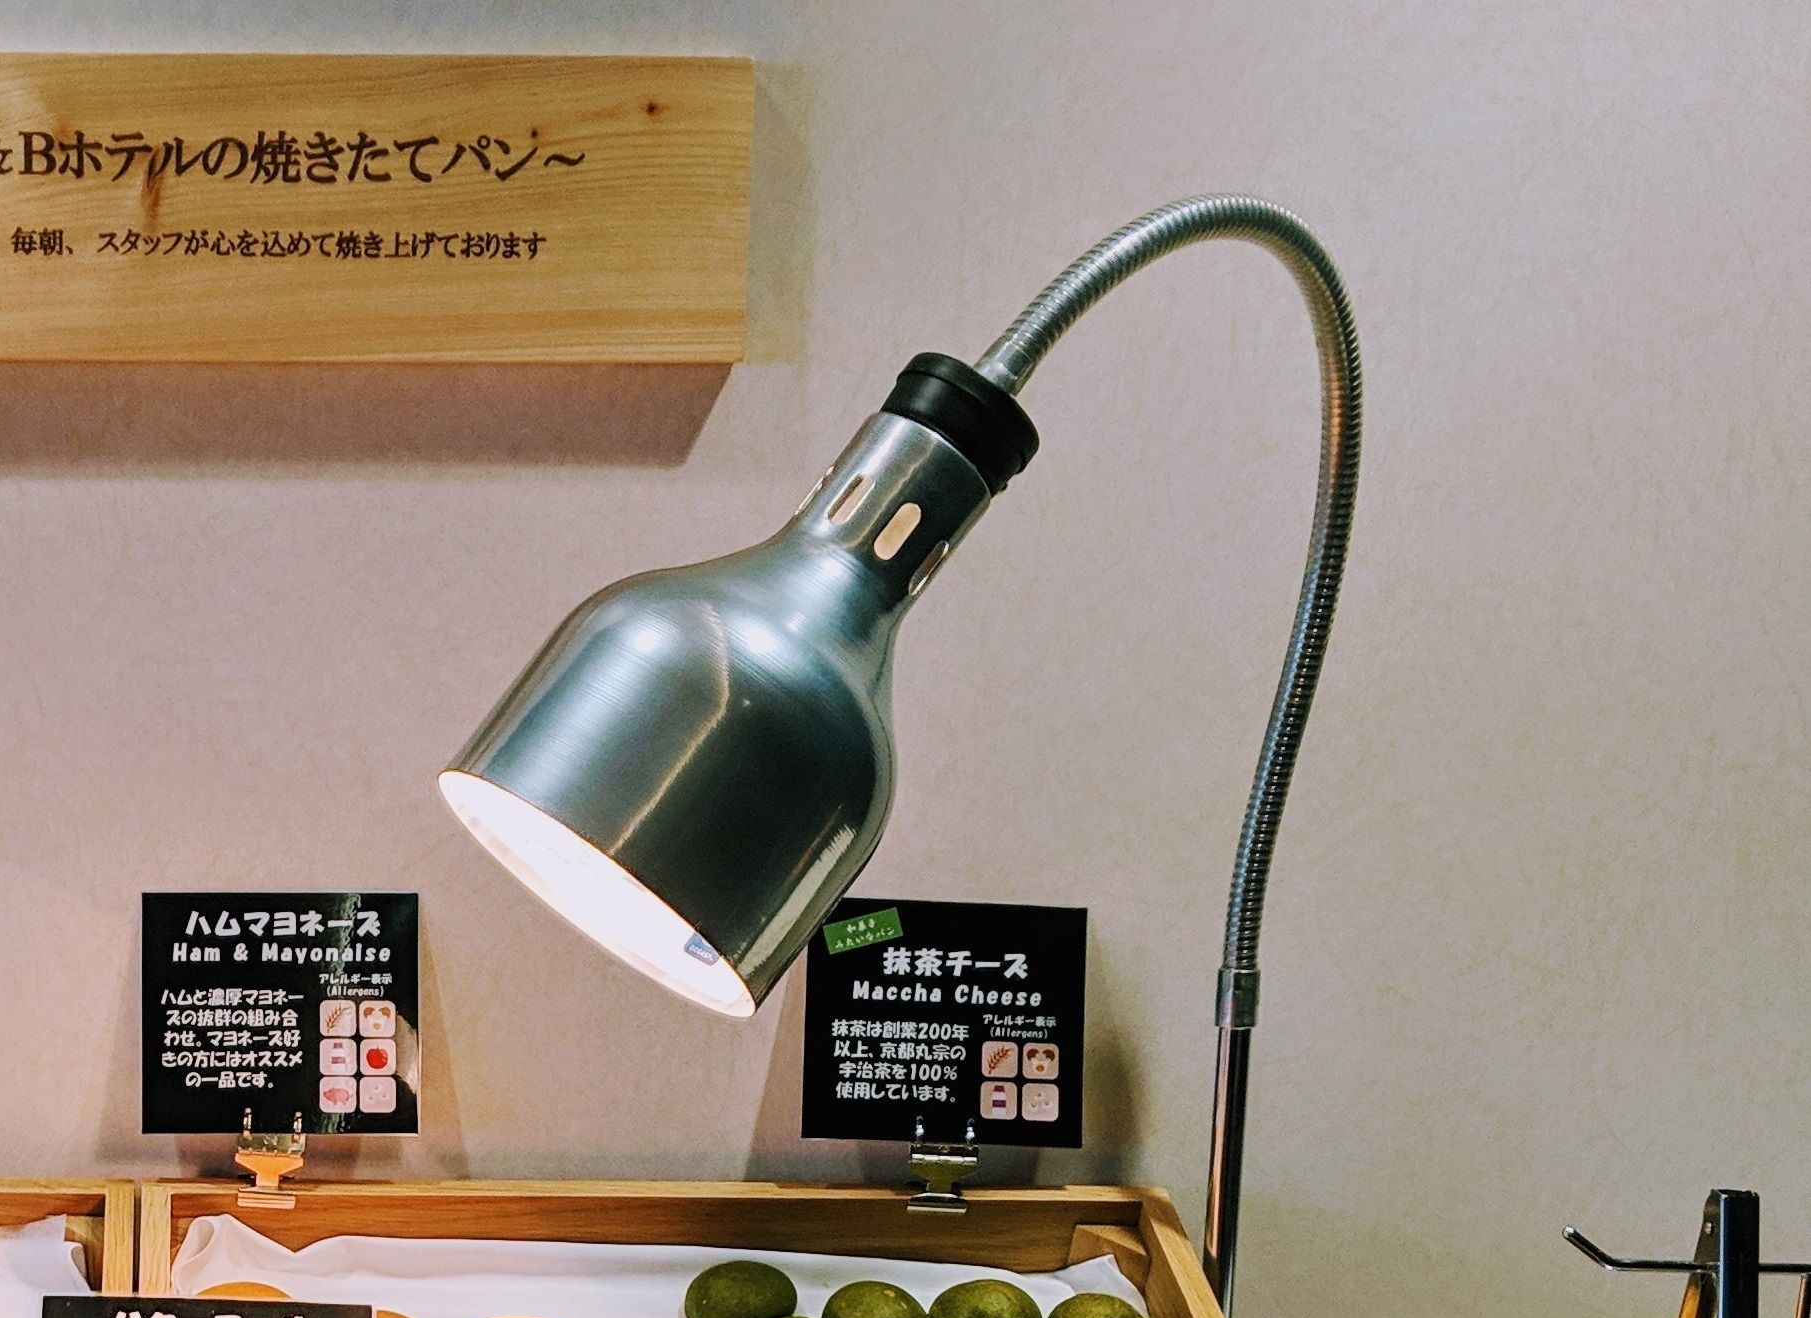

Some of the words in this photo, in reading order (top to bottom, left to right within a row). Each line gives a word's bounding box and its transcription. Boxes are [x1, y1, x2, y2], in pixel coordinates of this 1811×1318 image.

[185, 911, 380, 937] ハムマヨネーズ
[173, 943, 220, 961] Ham
[234, 943, 248, 961] &
[262, 942, 391, 964] Mayonaise
[883, 947, 1028, 979] 抹茶チーズ
[161, 988, 304, 1006] ハムと濃厚マヨネー
[853, 981, 941, 1002] Maccha
[955, 985, 1041, 1006] Cheese
[167, 1009, 298, 1026] ズの抜群の組み合
[164, 1030, 301, 1047] わせ。マヨネーズ好
[832, 1019, 969, 1041] 抹茶は創業200年
[162, 1050, 303, 1067] きの方にはオススメ
[186, 1071, 273, 1088] の一品です。
[836, 1081, 955, 1102] 使用しています。
